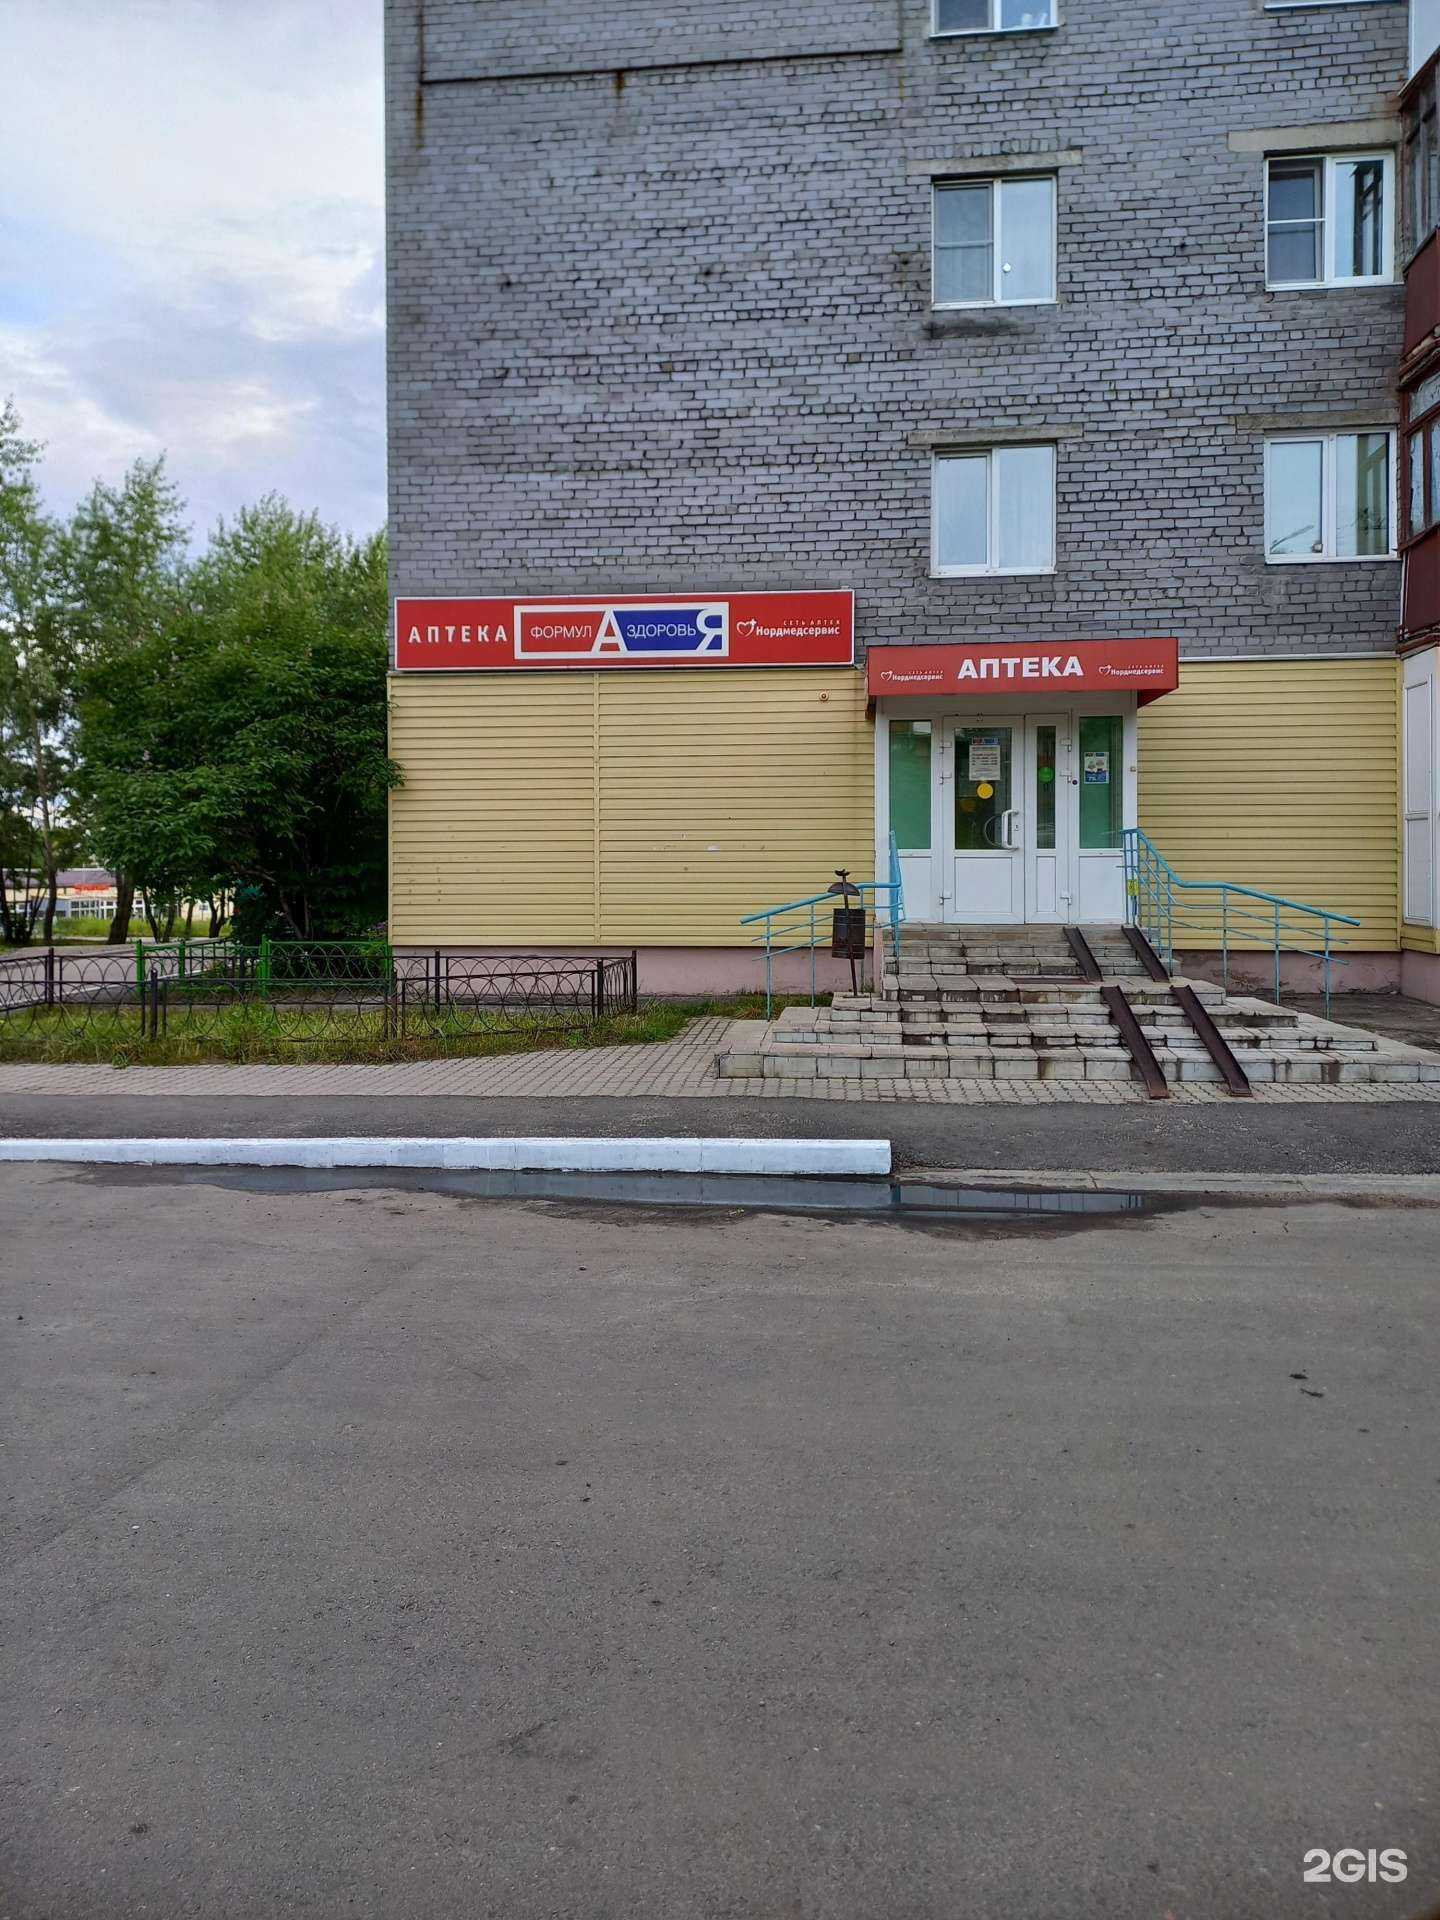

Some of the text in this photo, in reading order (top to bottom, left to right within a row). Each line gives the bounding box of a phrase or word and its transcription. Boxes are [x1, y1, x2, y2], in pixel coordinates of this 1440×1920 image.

[530, 609, 725, 653] ФОРМУЛА ЗДОРОВЬЯ
[756, 625, 841, 638] Нордмедсервис
[810, 618, 841, 626] АПТЕК
[408, 624, 508, 643] АПТЕКА
[957, 656, 1084, 679] АПТЕКА
